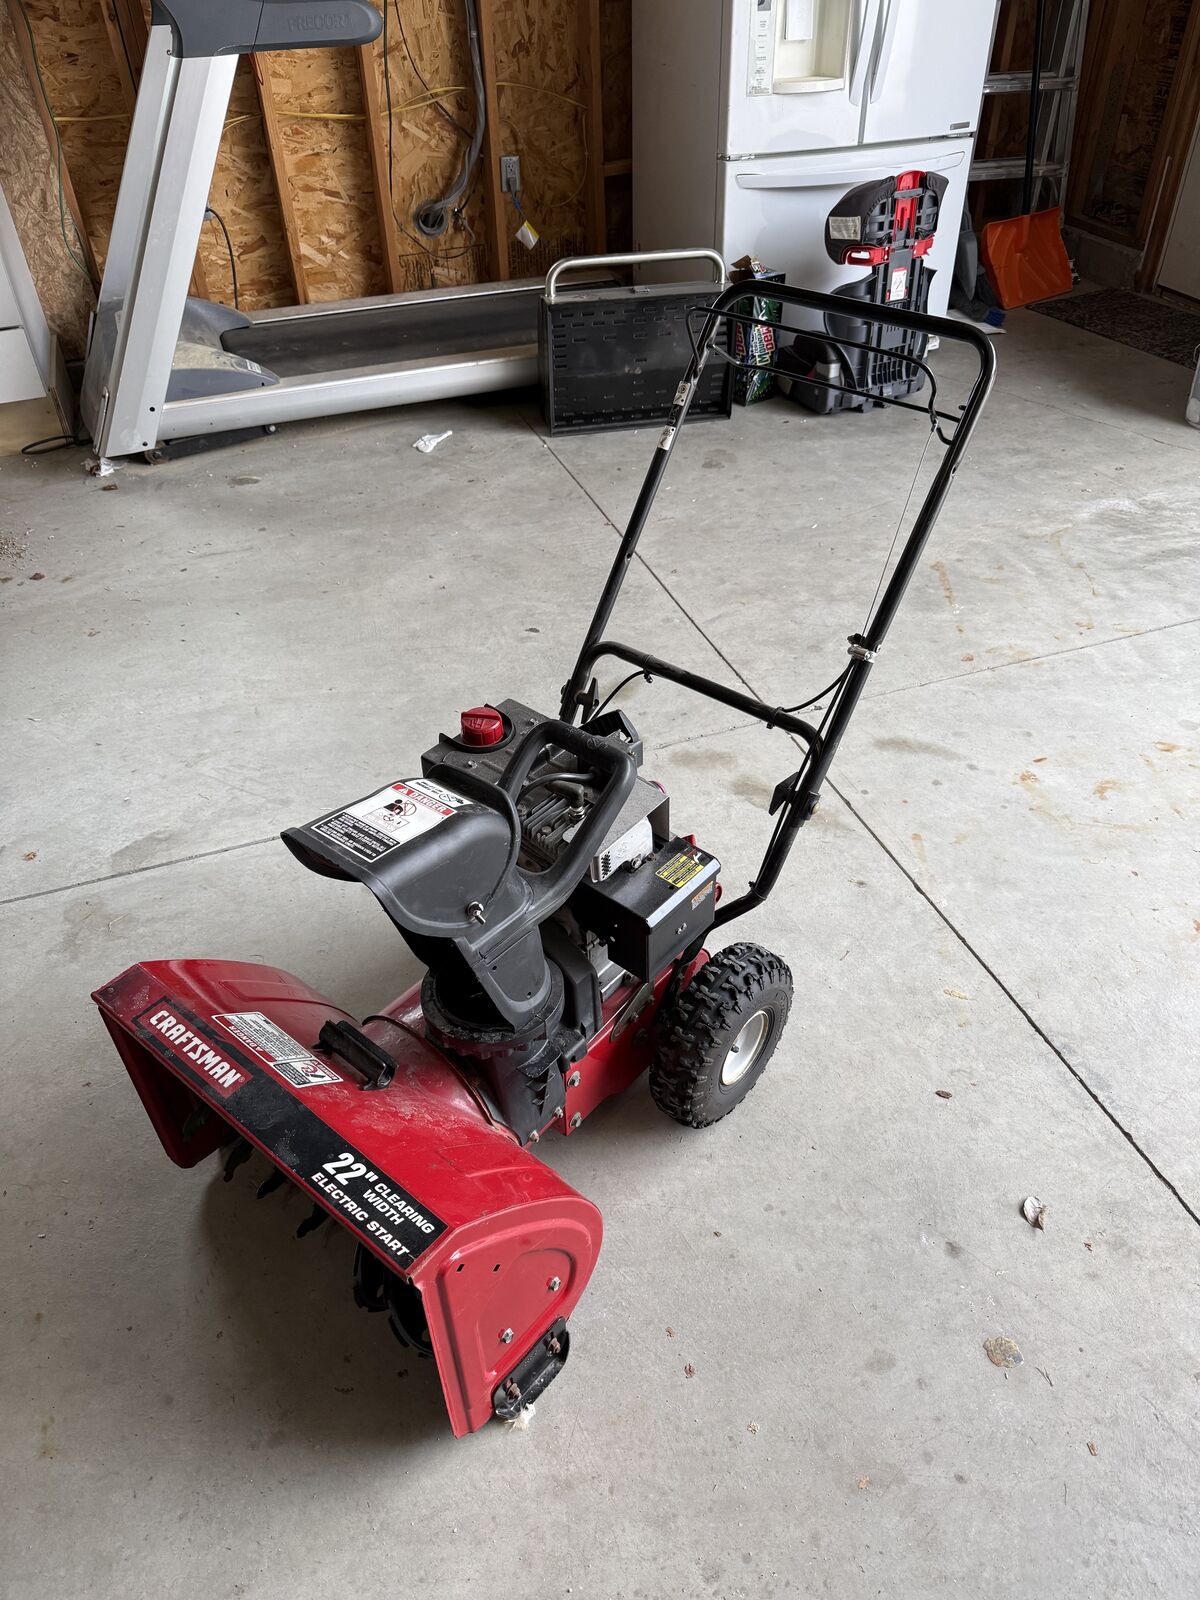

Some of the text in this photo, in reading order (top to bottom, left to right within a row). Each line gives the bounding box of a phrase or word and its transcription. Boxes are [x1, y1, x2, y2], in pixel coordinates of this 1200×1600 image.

[411, 791, 447, 813] DANGER
[228, 1025, 257, 1049] DANGER
[322, 1152, 435, 1234] 22" CLEARING
[362, 1189, 405, 1225] WIDTH
[311, 1172, 410, 1256] ELECTRIC START
